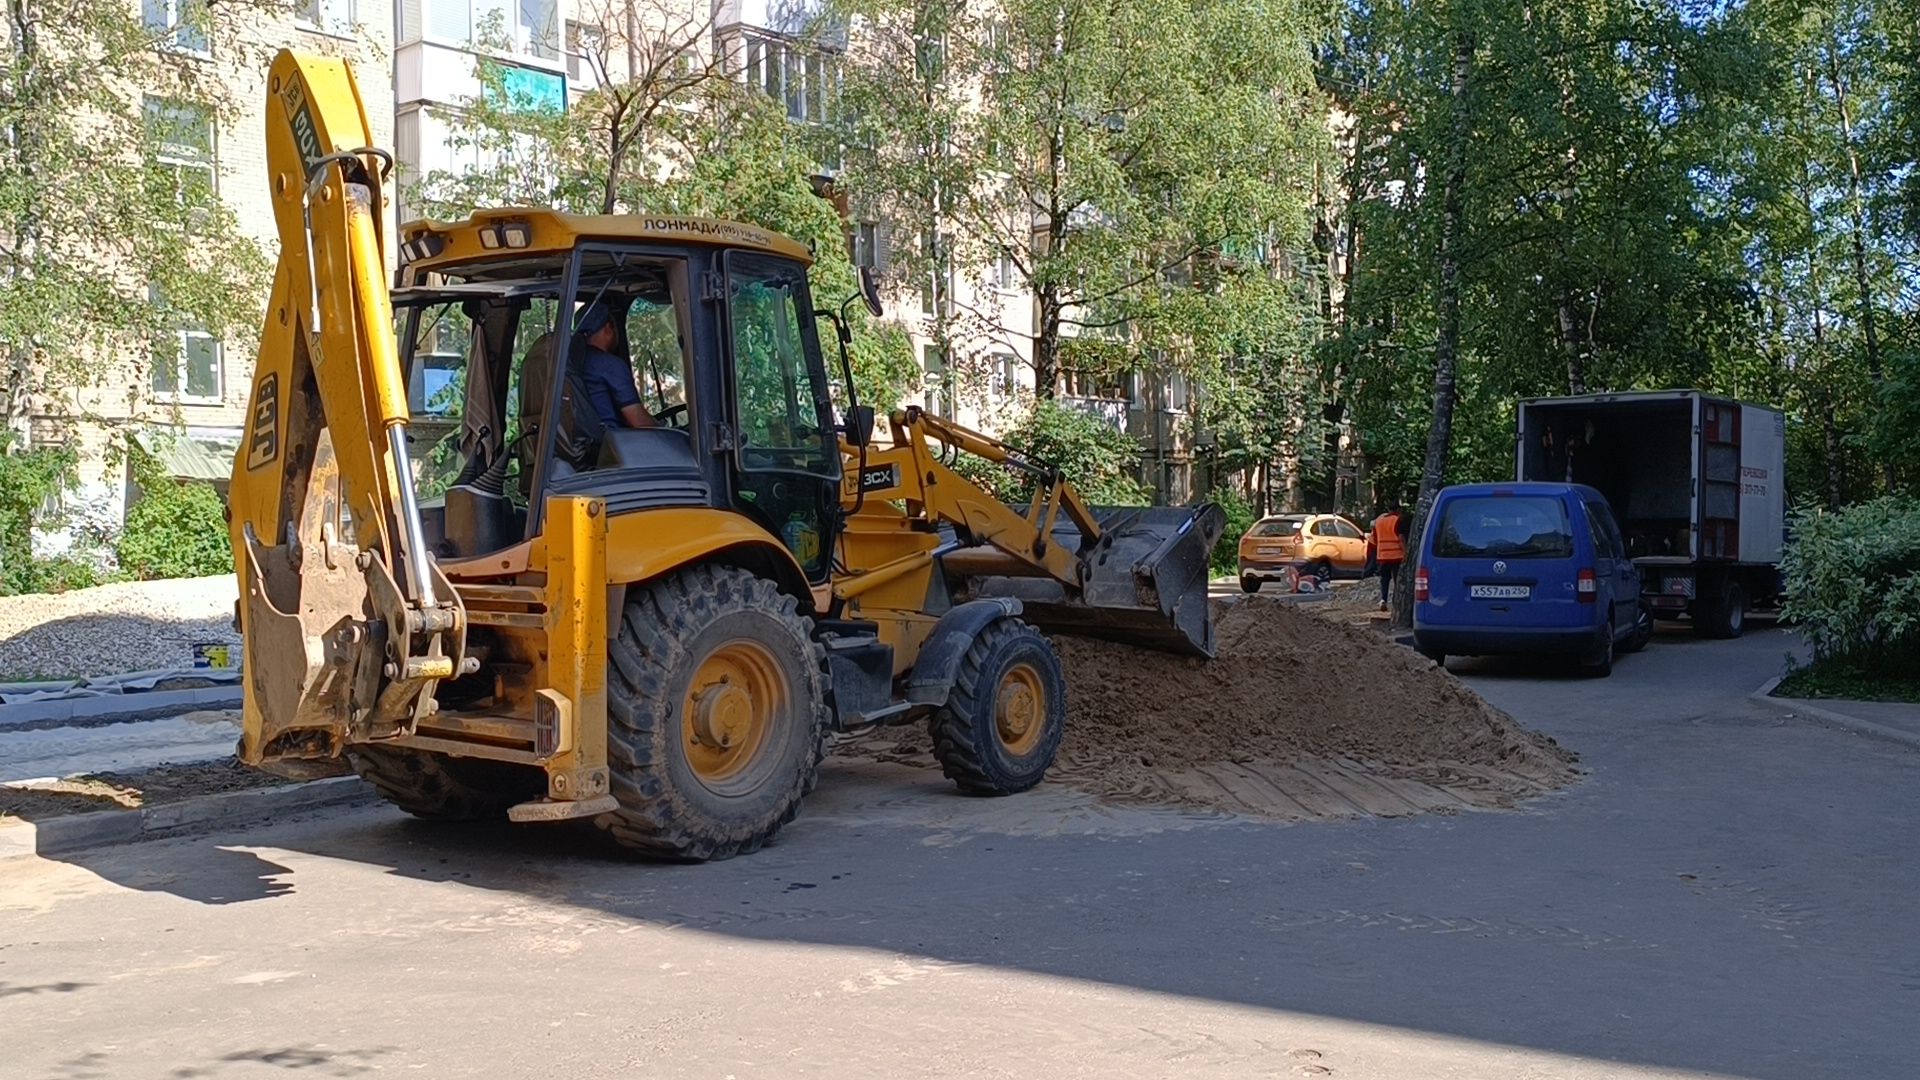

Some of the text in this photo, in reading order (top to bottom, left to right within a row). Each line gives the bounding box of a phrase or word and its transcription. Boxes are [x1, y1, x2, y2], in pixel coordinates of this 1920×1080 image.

[644, 218, 720, 235] ЛОНМАДИ
[252, 379, 276, 458] JCB
[863, 470, 891, 485] 3CX
